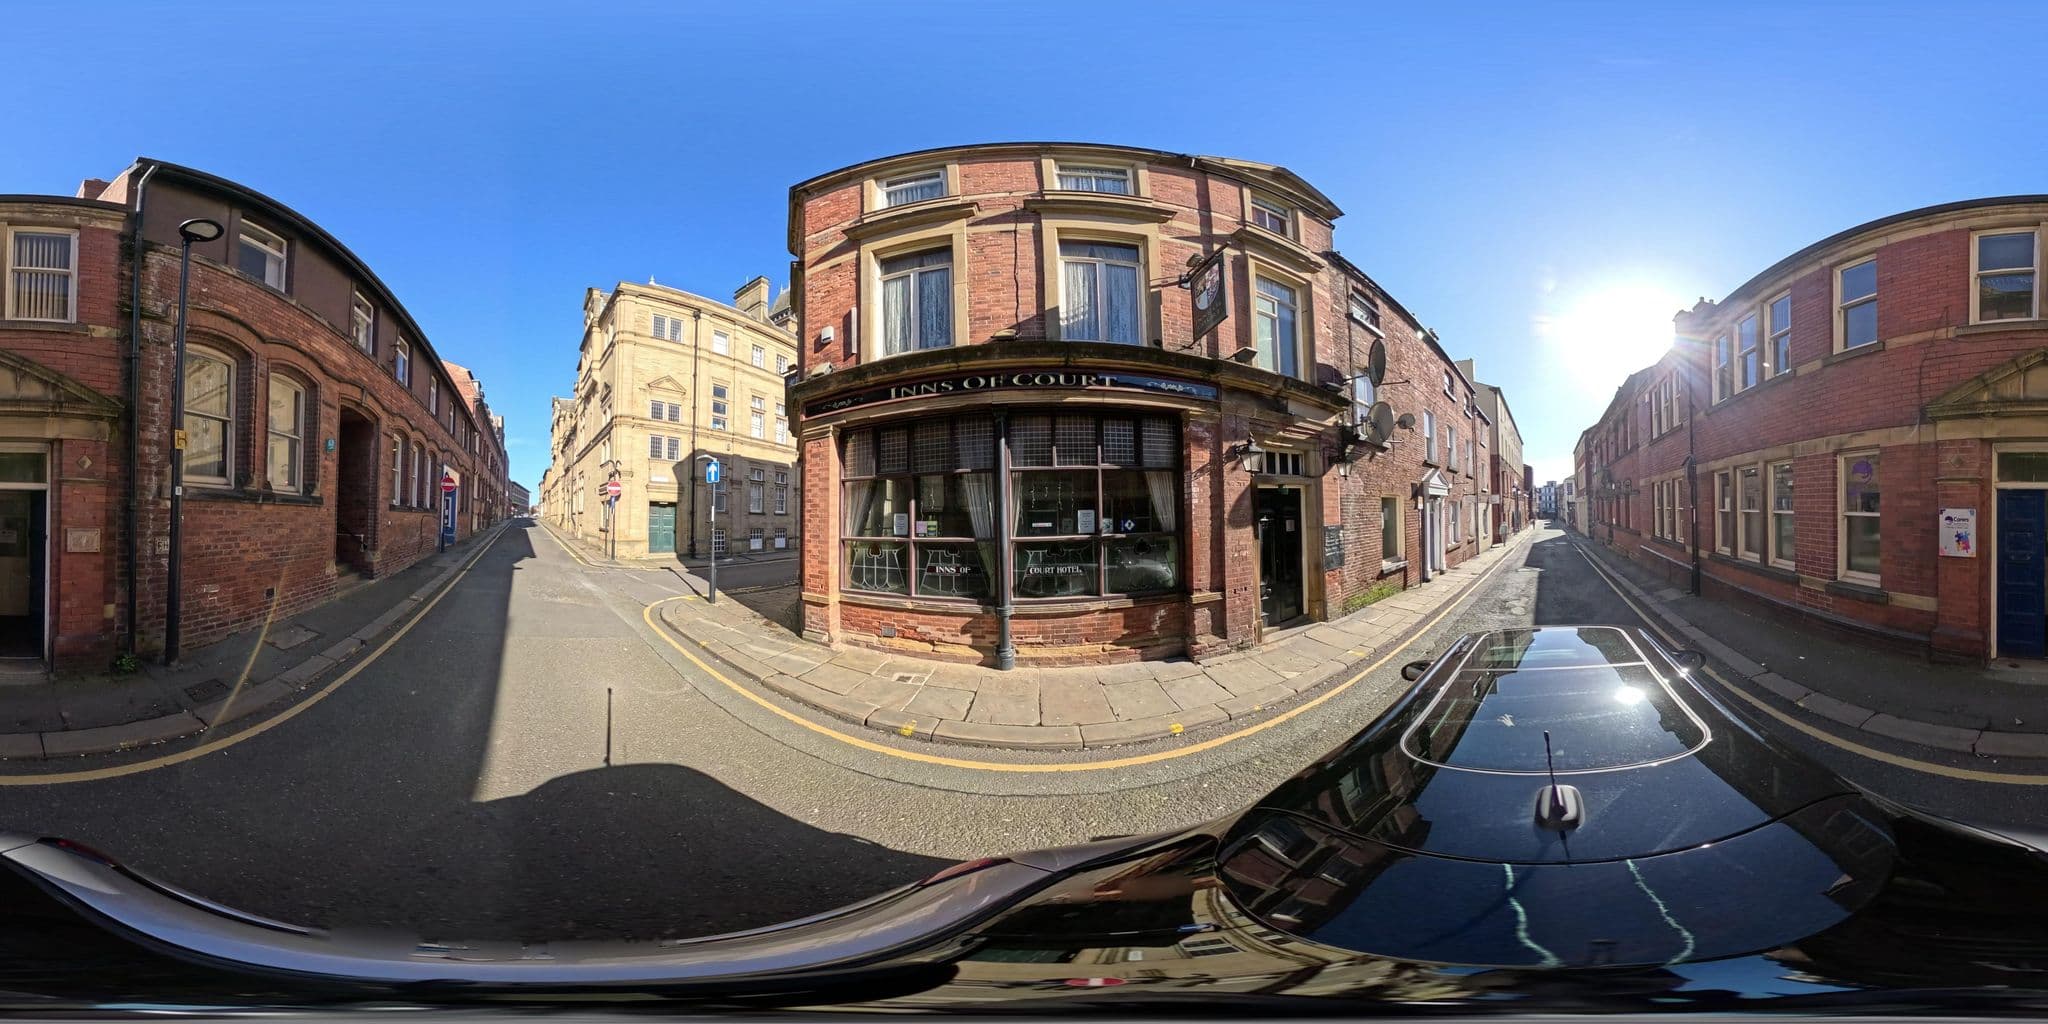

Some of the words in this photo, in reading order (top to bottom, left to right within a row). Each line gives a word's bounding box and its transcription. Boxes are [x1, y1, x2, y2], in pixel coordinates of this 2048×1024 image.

[890, 380, 953, 400] INNS
[963, 376, 1004, 389] OF
[1012, 373, 1117, 387] COURT
[936, 566, 956, 574] INNS
[959, 566, 972, 574] OF
[1029, 566, 1055, 574] COURT
[1056, 565, 1082, 574] HOTEL
